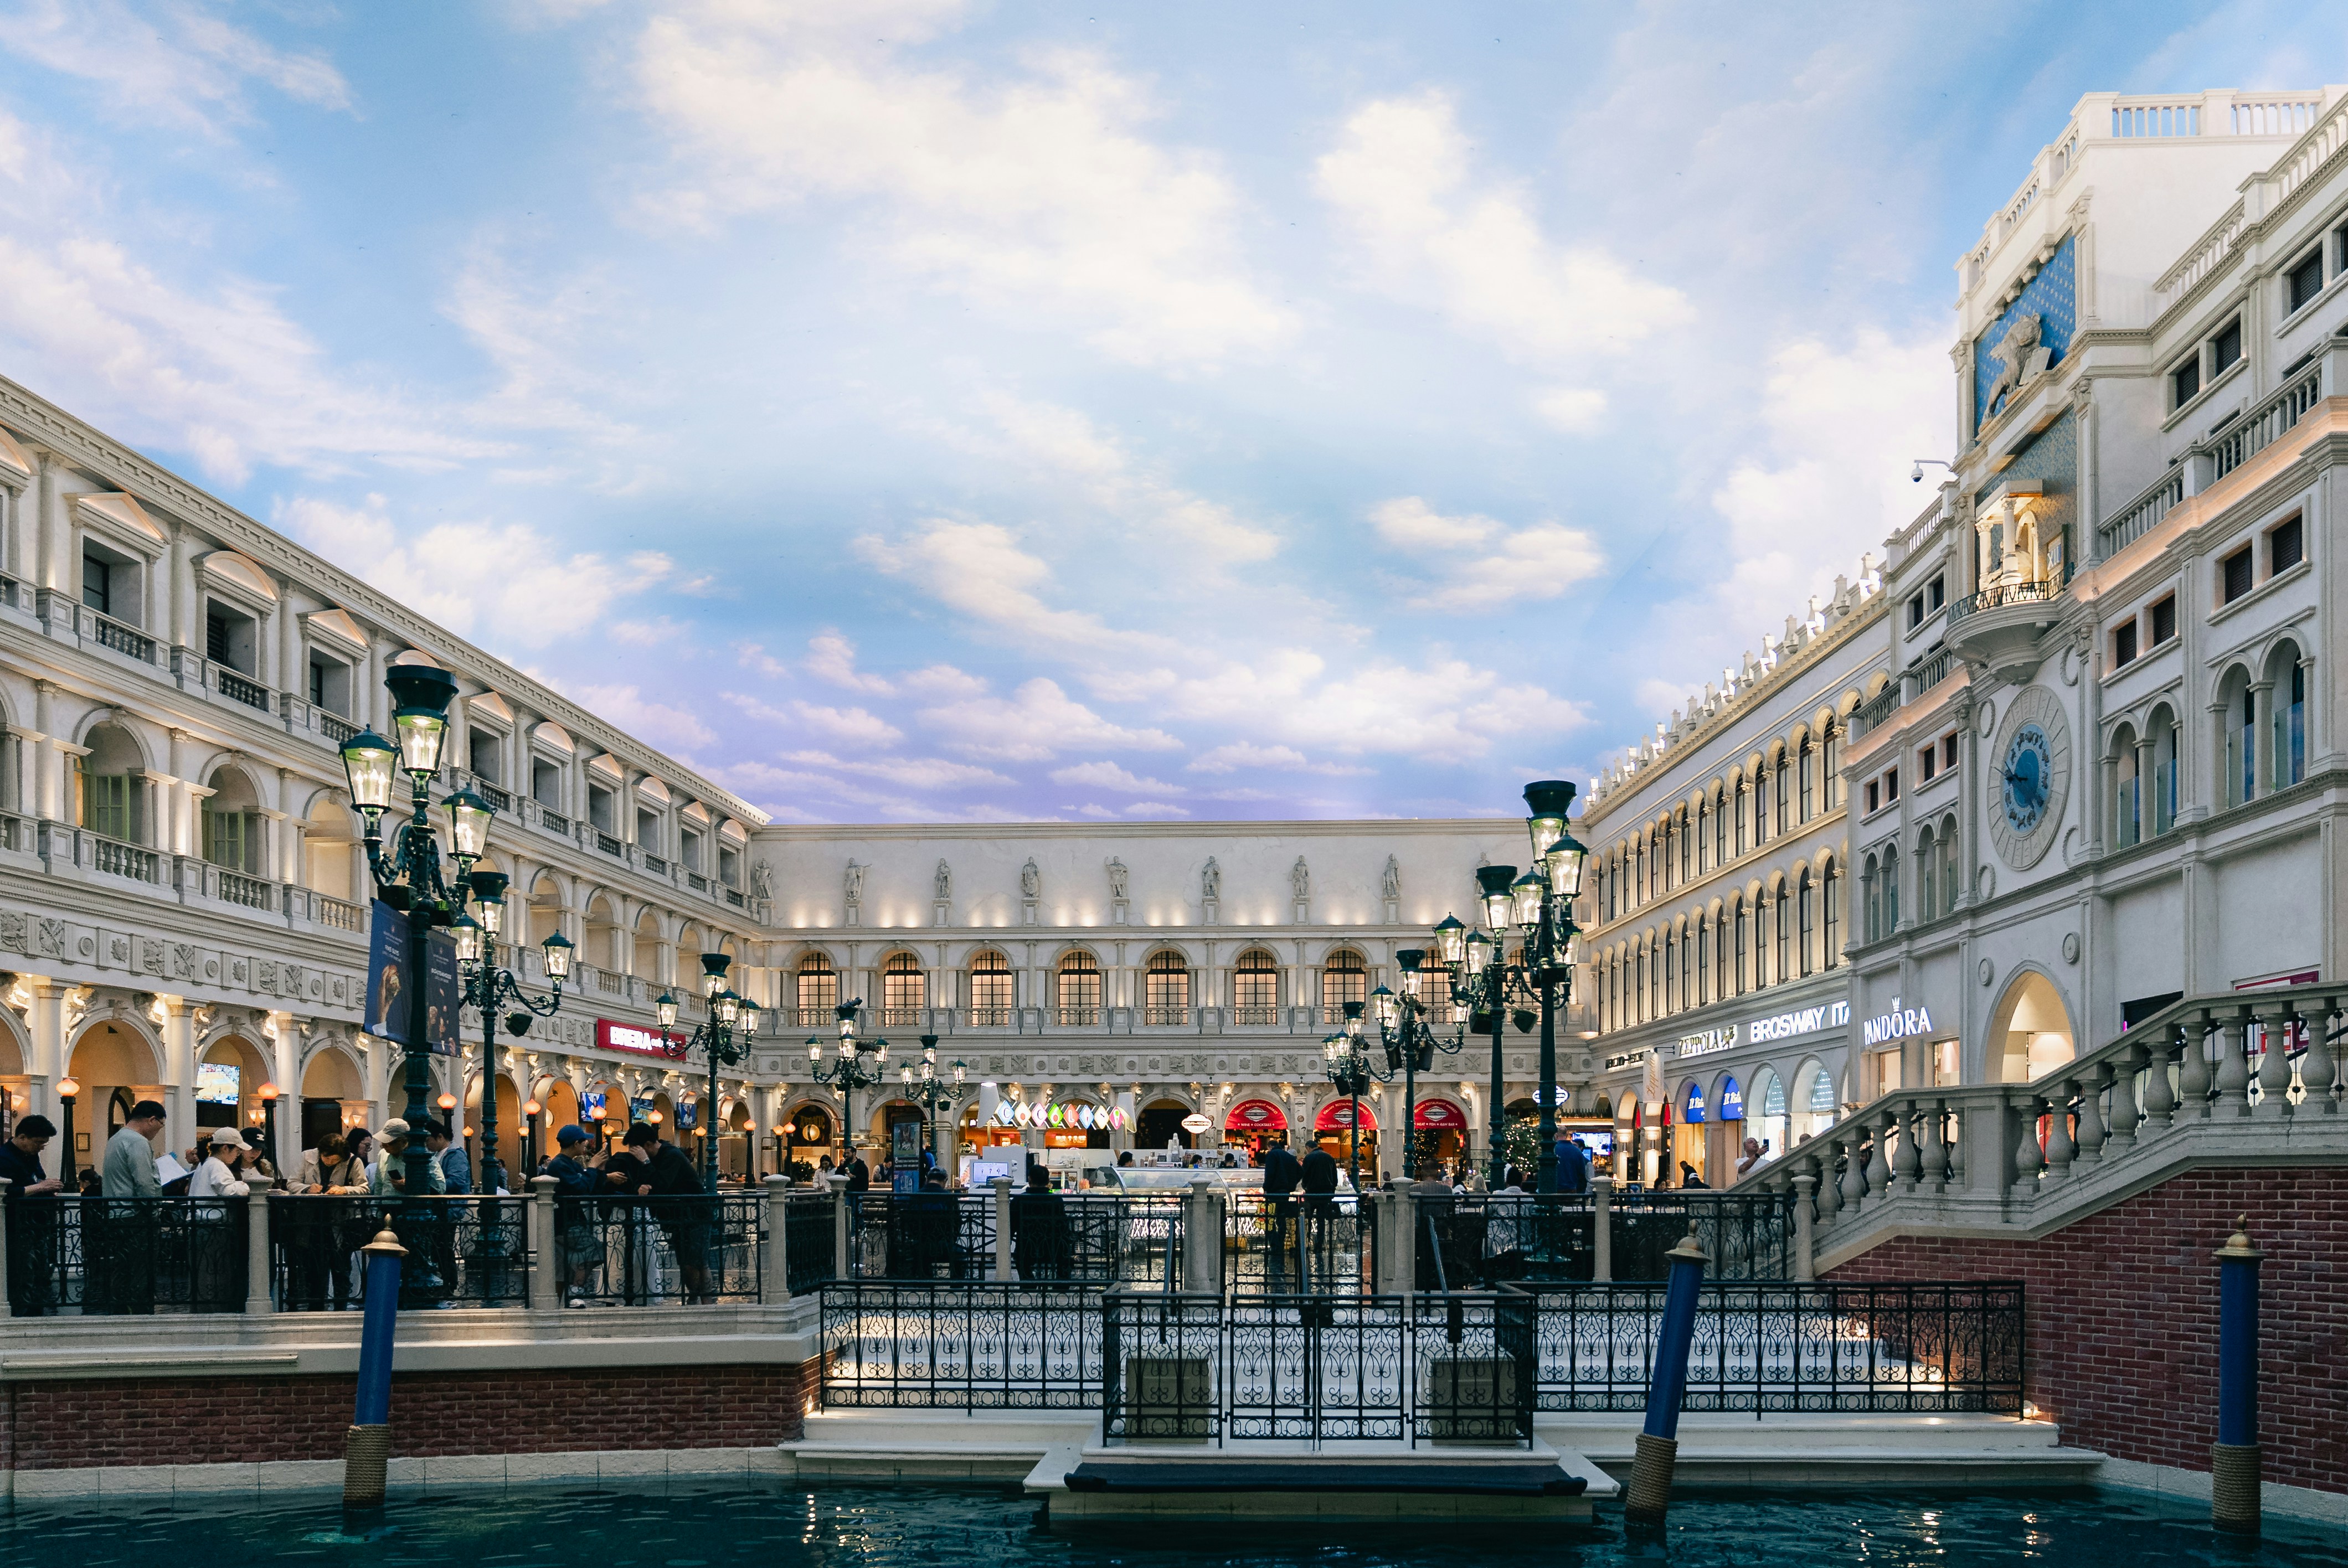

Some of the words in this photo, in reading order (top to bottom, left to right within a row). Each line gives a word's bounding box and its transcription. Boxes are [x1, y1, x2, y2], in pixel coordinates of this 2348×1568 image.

[610, 1026, 652, 1051] BRERA
[1750, 1005, 1826, 1043] BROSWAY
[1863, 1007, 1932, 1045] PANDORA
[1678, 1031, 1719, 1056] ZEPPOLA
